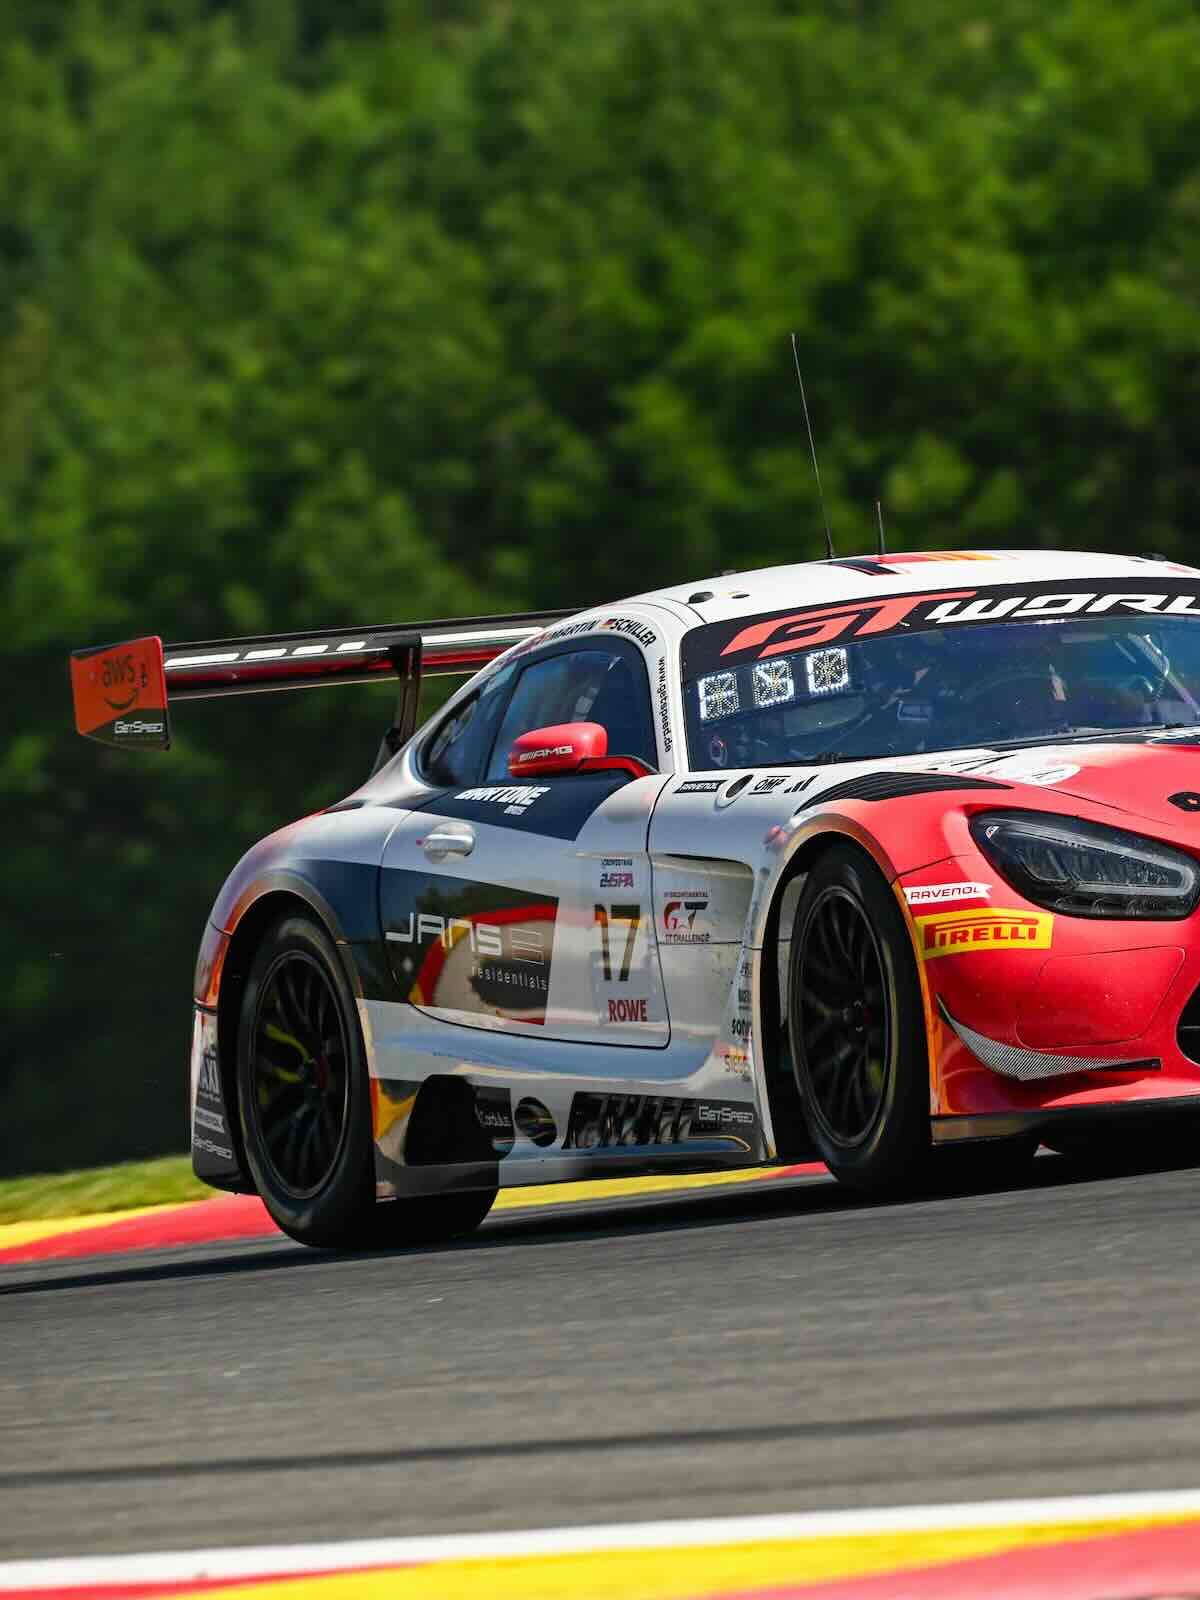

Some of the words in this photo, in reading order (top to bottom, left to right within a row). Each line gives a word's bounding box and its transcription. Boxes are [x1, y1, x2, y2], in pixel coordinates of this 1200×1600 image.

[611, 618, 657, 648] SCHILLER
[720, 591, 977, 659] GT
[657, 656, 673, 752] www.getspeed.de
[910, 886, 979, 900] RAVENOL
[594, 904, 640, 981] 17
[923, 915, 1040, 950] PIRELLI
[472, 966, 549, 991] residentials
[608, 999, 648, 1022] ROWE
